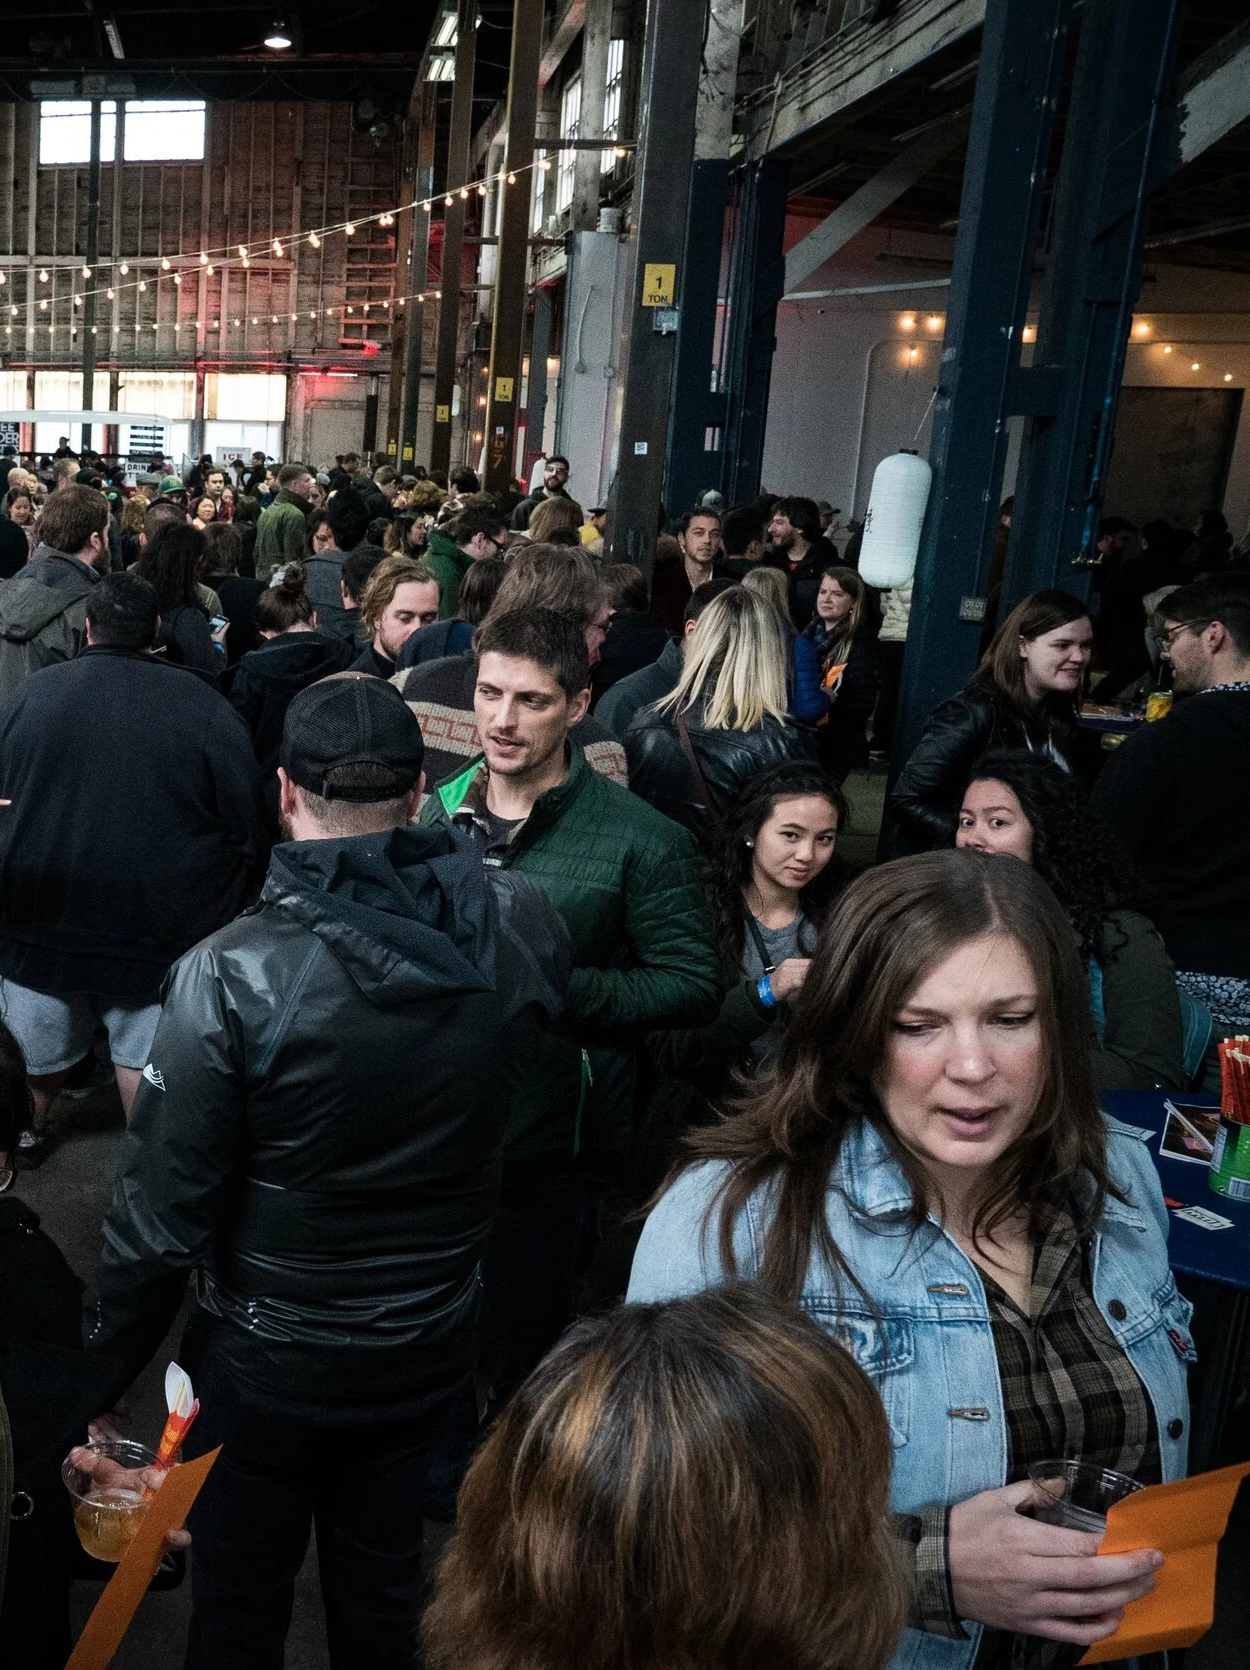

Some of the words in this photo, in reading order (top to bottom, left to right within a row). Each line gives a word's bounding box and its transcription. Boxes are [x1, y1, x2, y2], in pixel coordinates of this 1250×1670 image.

[656, 276, 662, 289] 1
[648, 294, 668, 303] TON
[223, 453, 243, 461] ICE
[127, 463, 150, 471] DRIN
